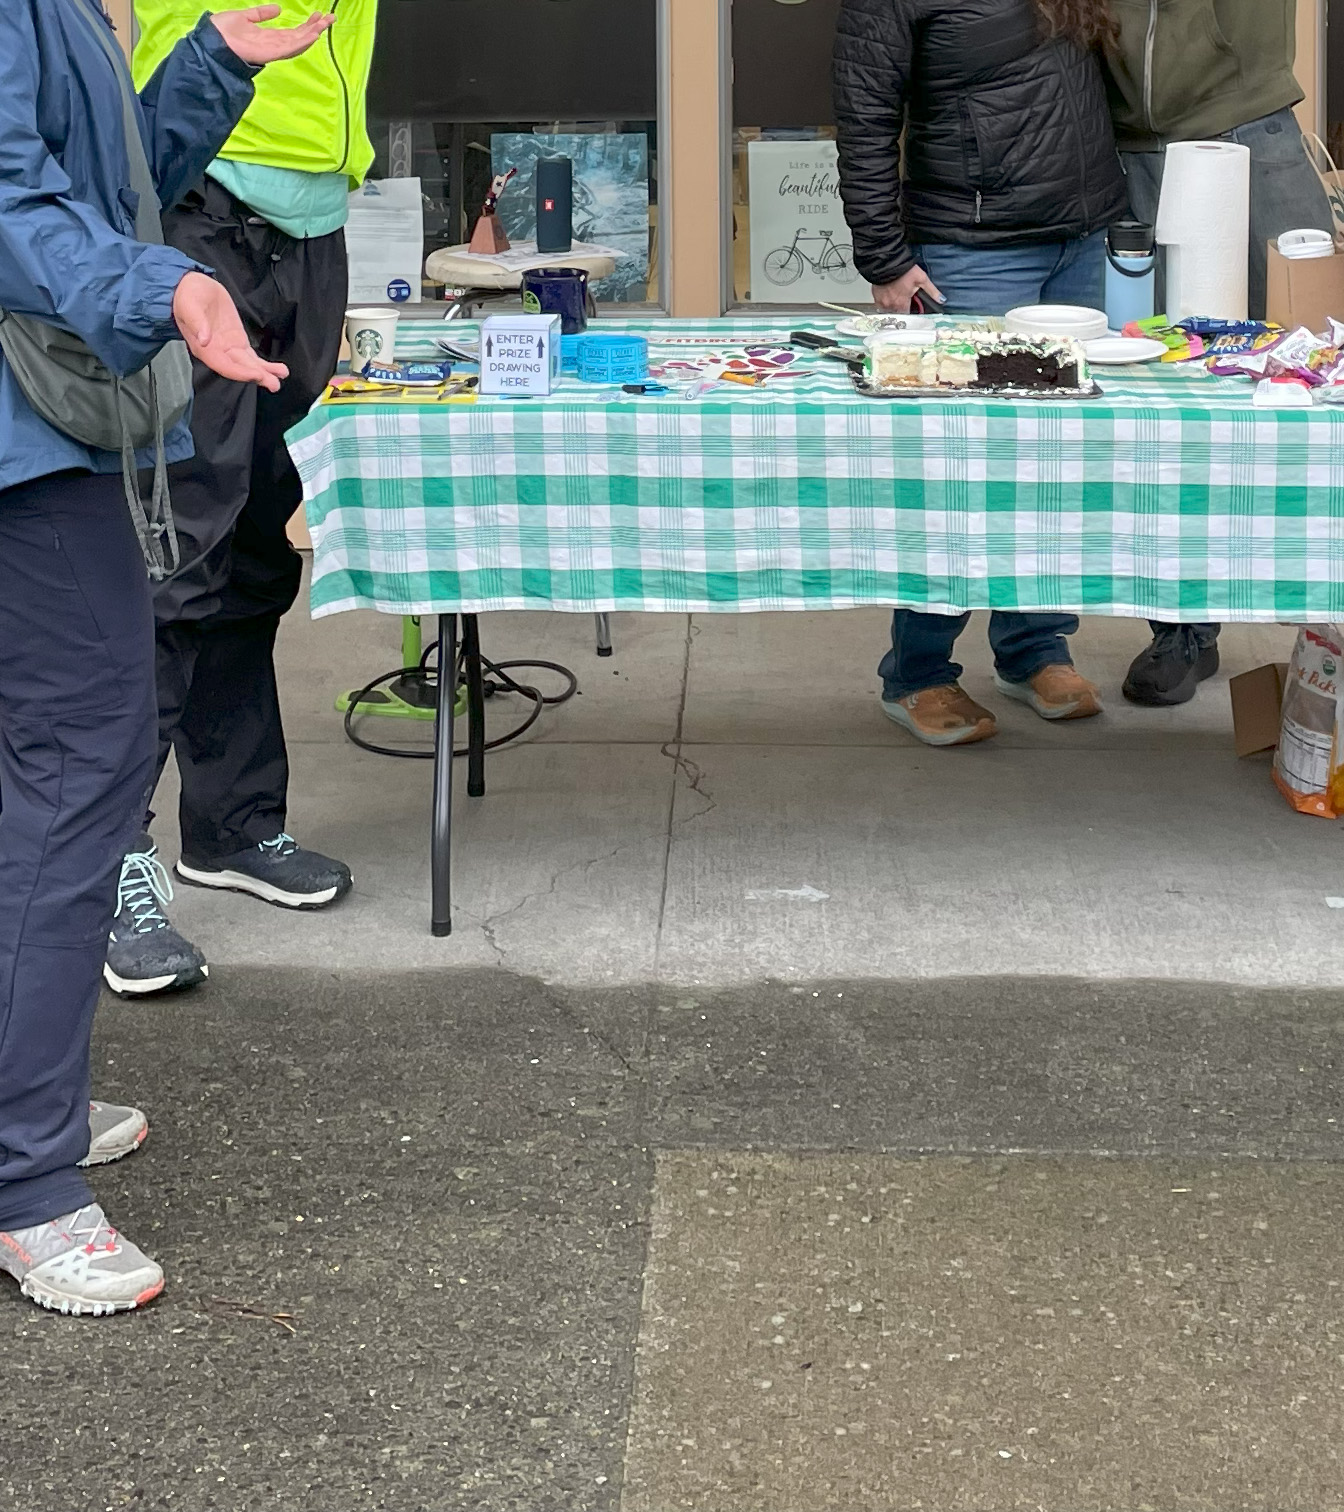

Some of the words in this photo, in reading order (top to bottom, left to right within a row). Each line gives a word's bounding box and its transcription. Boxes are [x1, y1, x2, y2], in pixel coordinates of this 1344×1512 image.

[778, 172, 841, 200] beautiful
[798, 204, 829, 215] RIDE
[496, 334, 534, 345] ENTER
[498, 348, 532, 359] PRIZE
[489, 362, 541, 373] DRAWING
[500, 377, 530, 387] HERE
